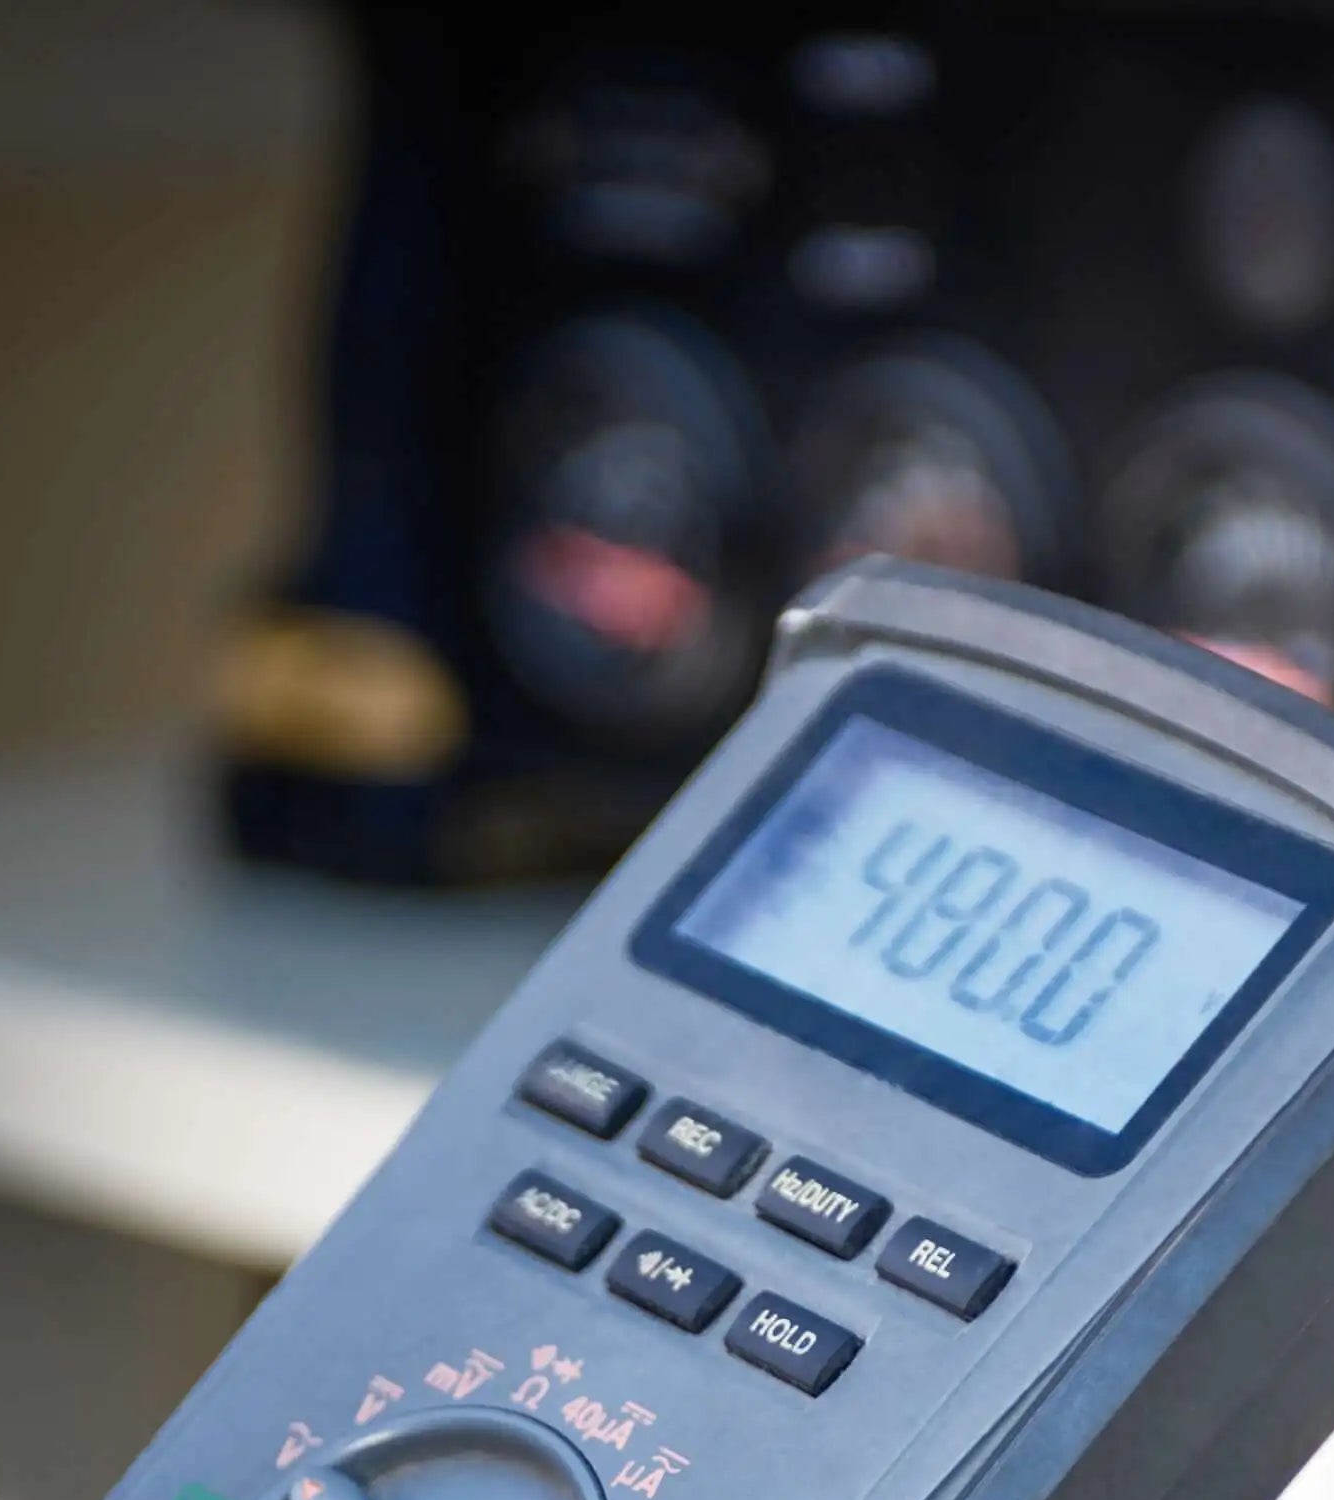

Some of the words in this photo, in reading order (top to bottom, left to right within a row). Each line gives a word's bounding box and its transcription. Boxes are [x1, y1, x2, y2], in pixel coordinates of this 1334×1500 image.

[667, 1116, 722, 1158] REC
[771, 1168, 860, 1223] Hz/DUTY
[908, 1239, 956, 1279] REL
[749, 1309, 817, 1355] HOLD
